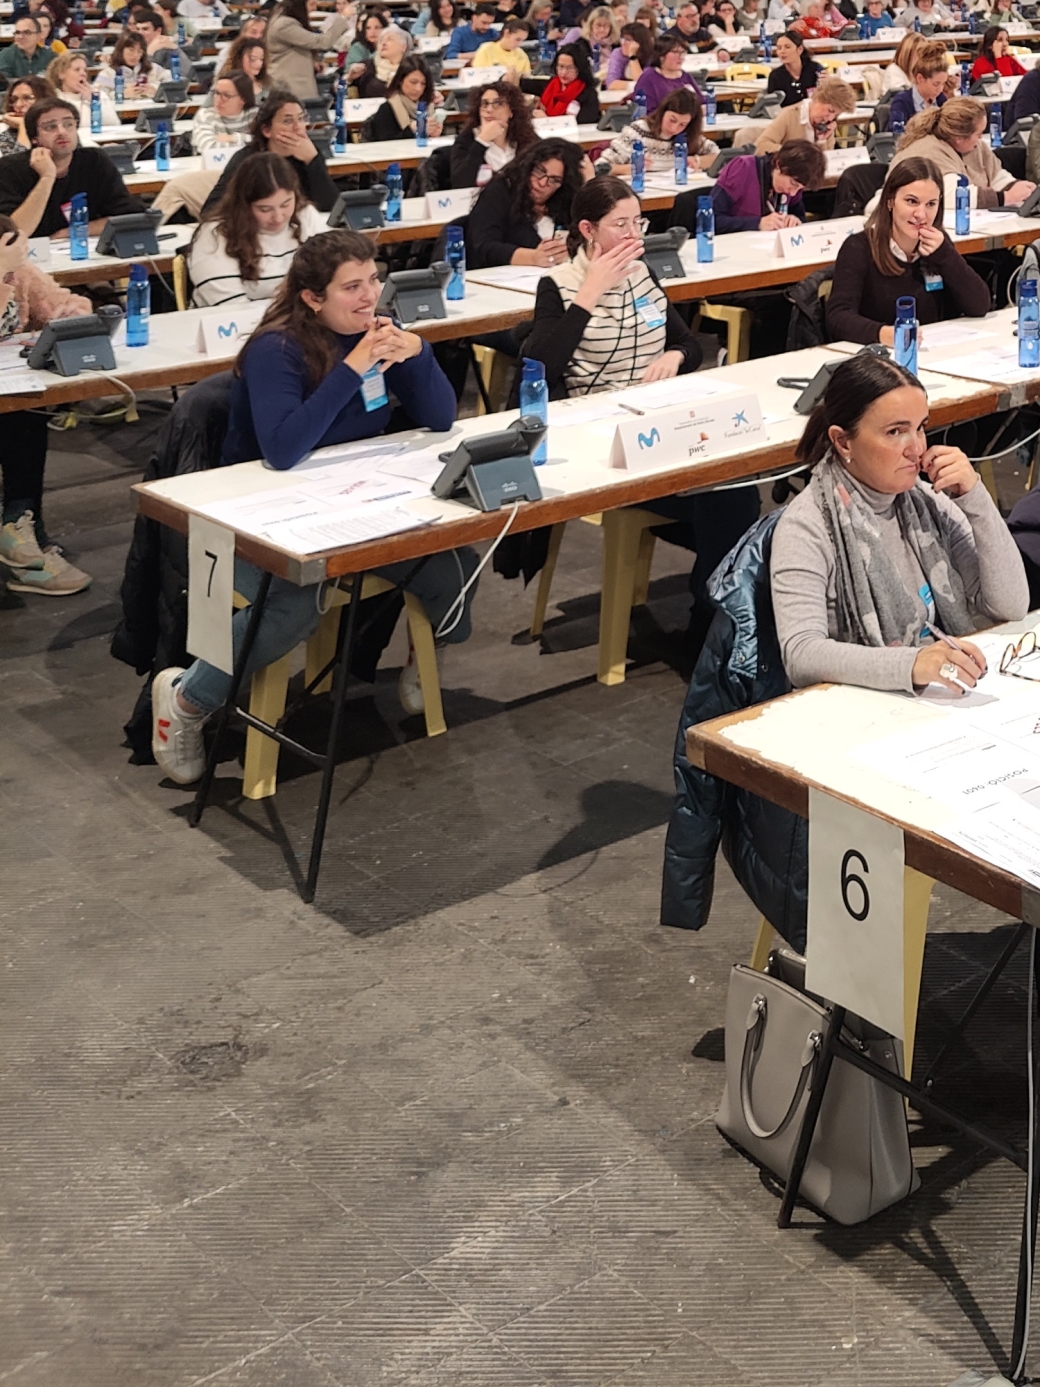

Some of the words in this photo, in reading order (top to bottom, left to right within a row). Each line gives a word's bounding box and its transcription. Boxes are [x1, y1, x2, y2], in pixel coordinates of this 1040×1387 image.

[688, 444, 706, 457] pwc
[205, 549, 217, 598] 7
[840, 848, 870, 922] 6
